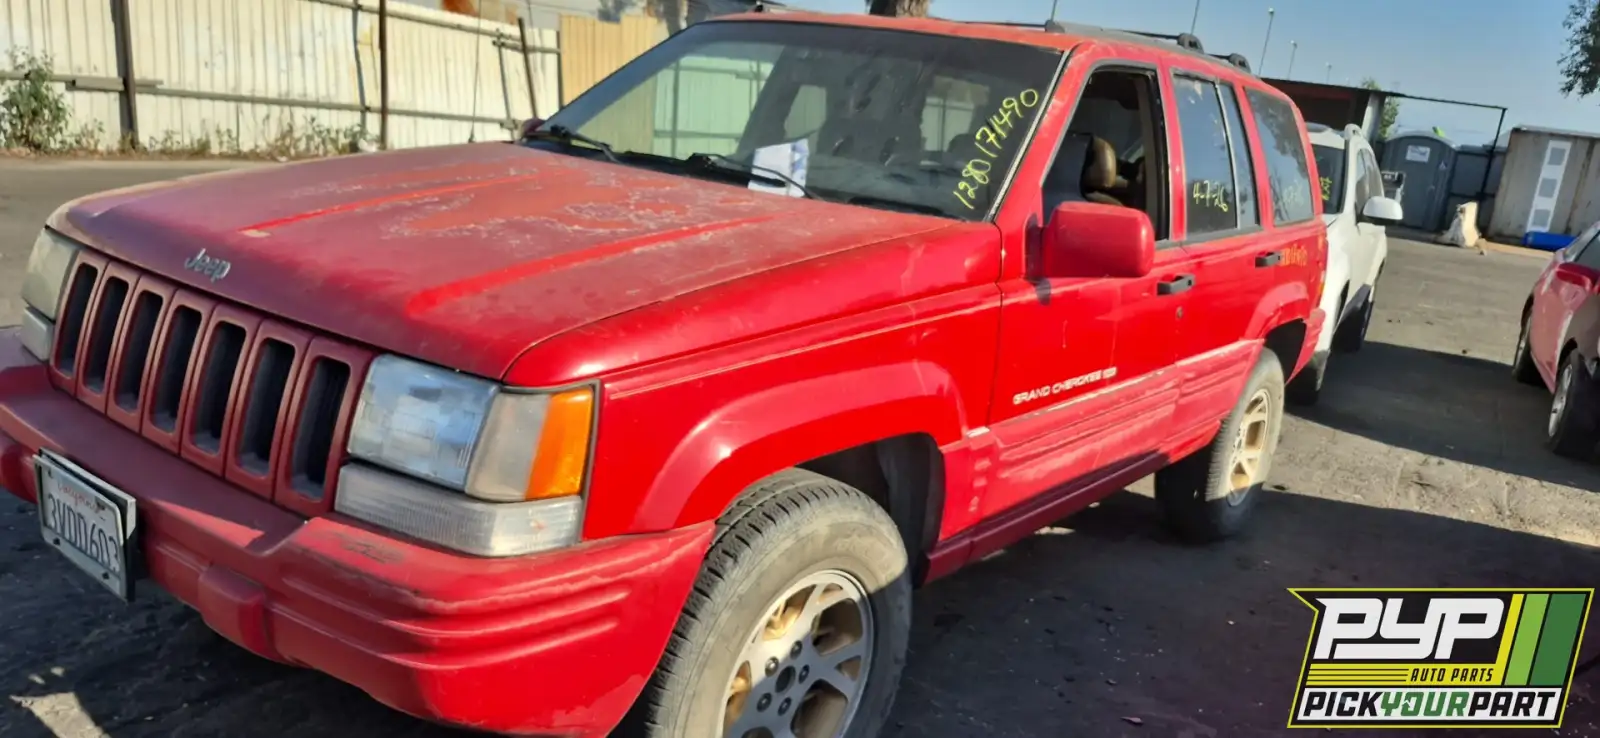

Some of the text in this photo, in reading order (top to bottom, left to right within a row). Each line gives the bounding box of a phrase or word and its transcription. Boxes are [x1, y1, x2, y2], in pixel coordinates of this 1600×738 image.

[953, 88, 1039, 210] 1280171490
[184, 248, 231, 284] Jeep
[1013, 385, 1051, 405] GRAND
[1052, 369, 1102, 394] CHEROKEE
[48, 494, 120, 575] 3VDD603
